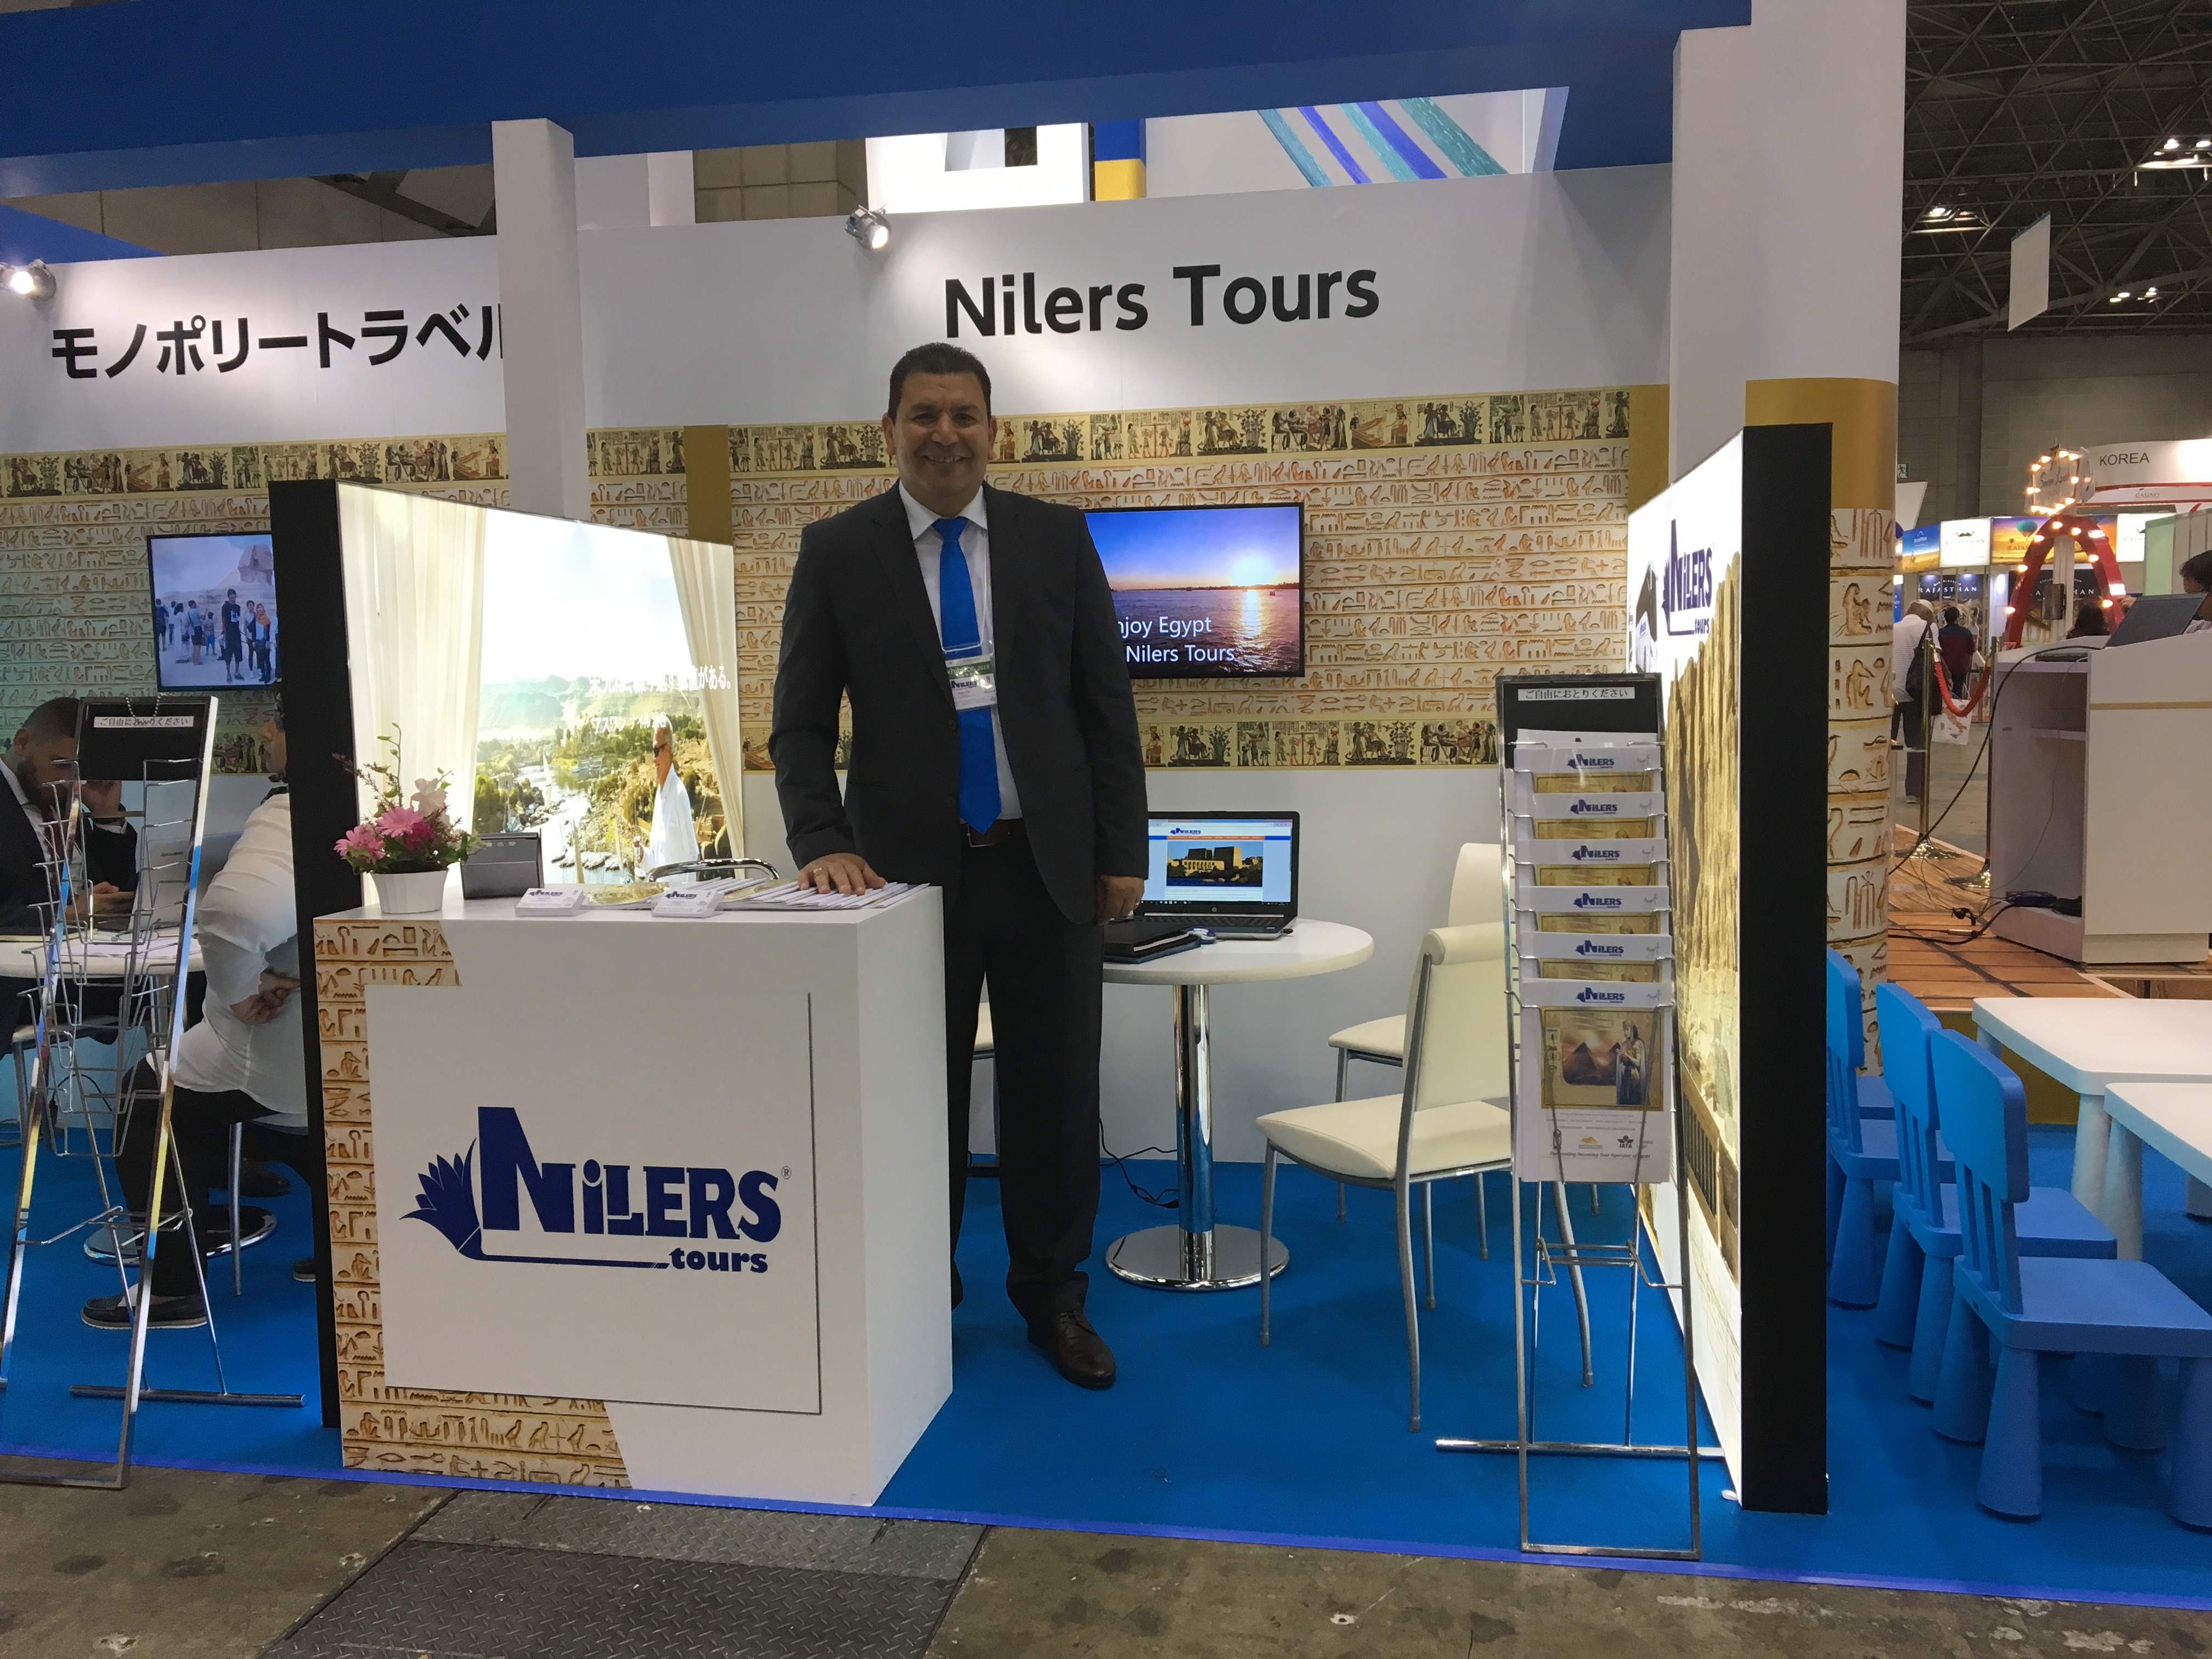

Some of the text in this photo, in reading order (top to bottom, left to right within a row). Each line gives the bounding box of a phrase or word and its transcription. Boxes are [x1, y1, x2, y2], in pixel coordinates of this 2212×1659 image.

[945, 264, 1380, 338] Nilers Tours
[2099, 452, 2151, 466] KOREA
[1118, 616, 1212, 639] njoy Egypt
[1694, 617, 1709, 635] tours
[1126, 644, 1235, 662] Nilers Tours
[1525, 689, 1628, 699] ご自由におとりください
[669, 1248, 768, 1273] tours
